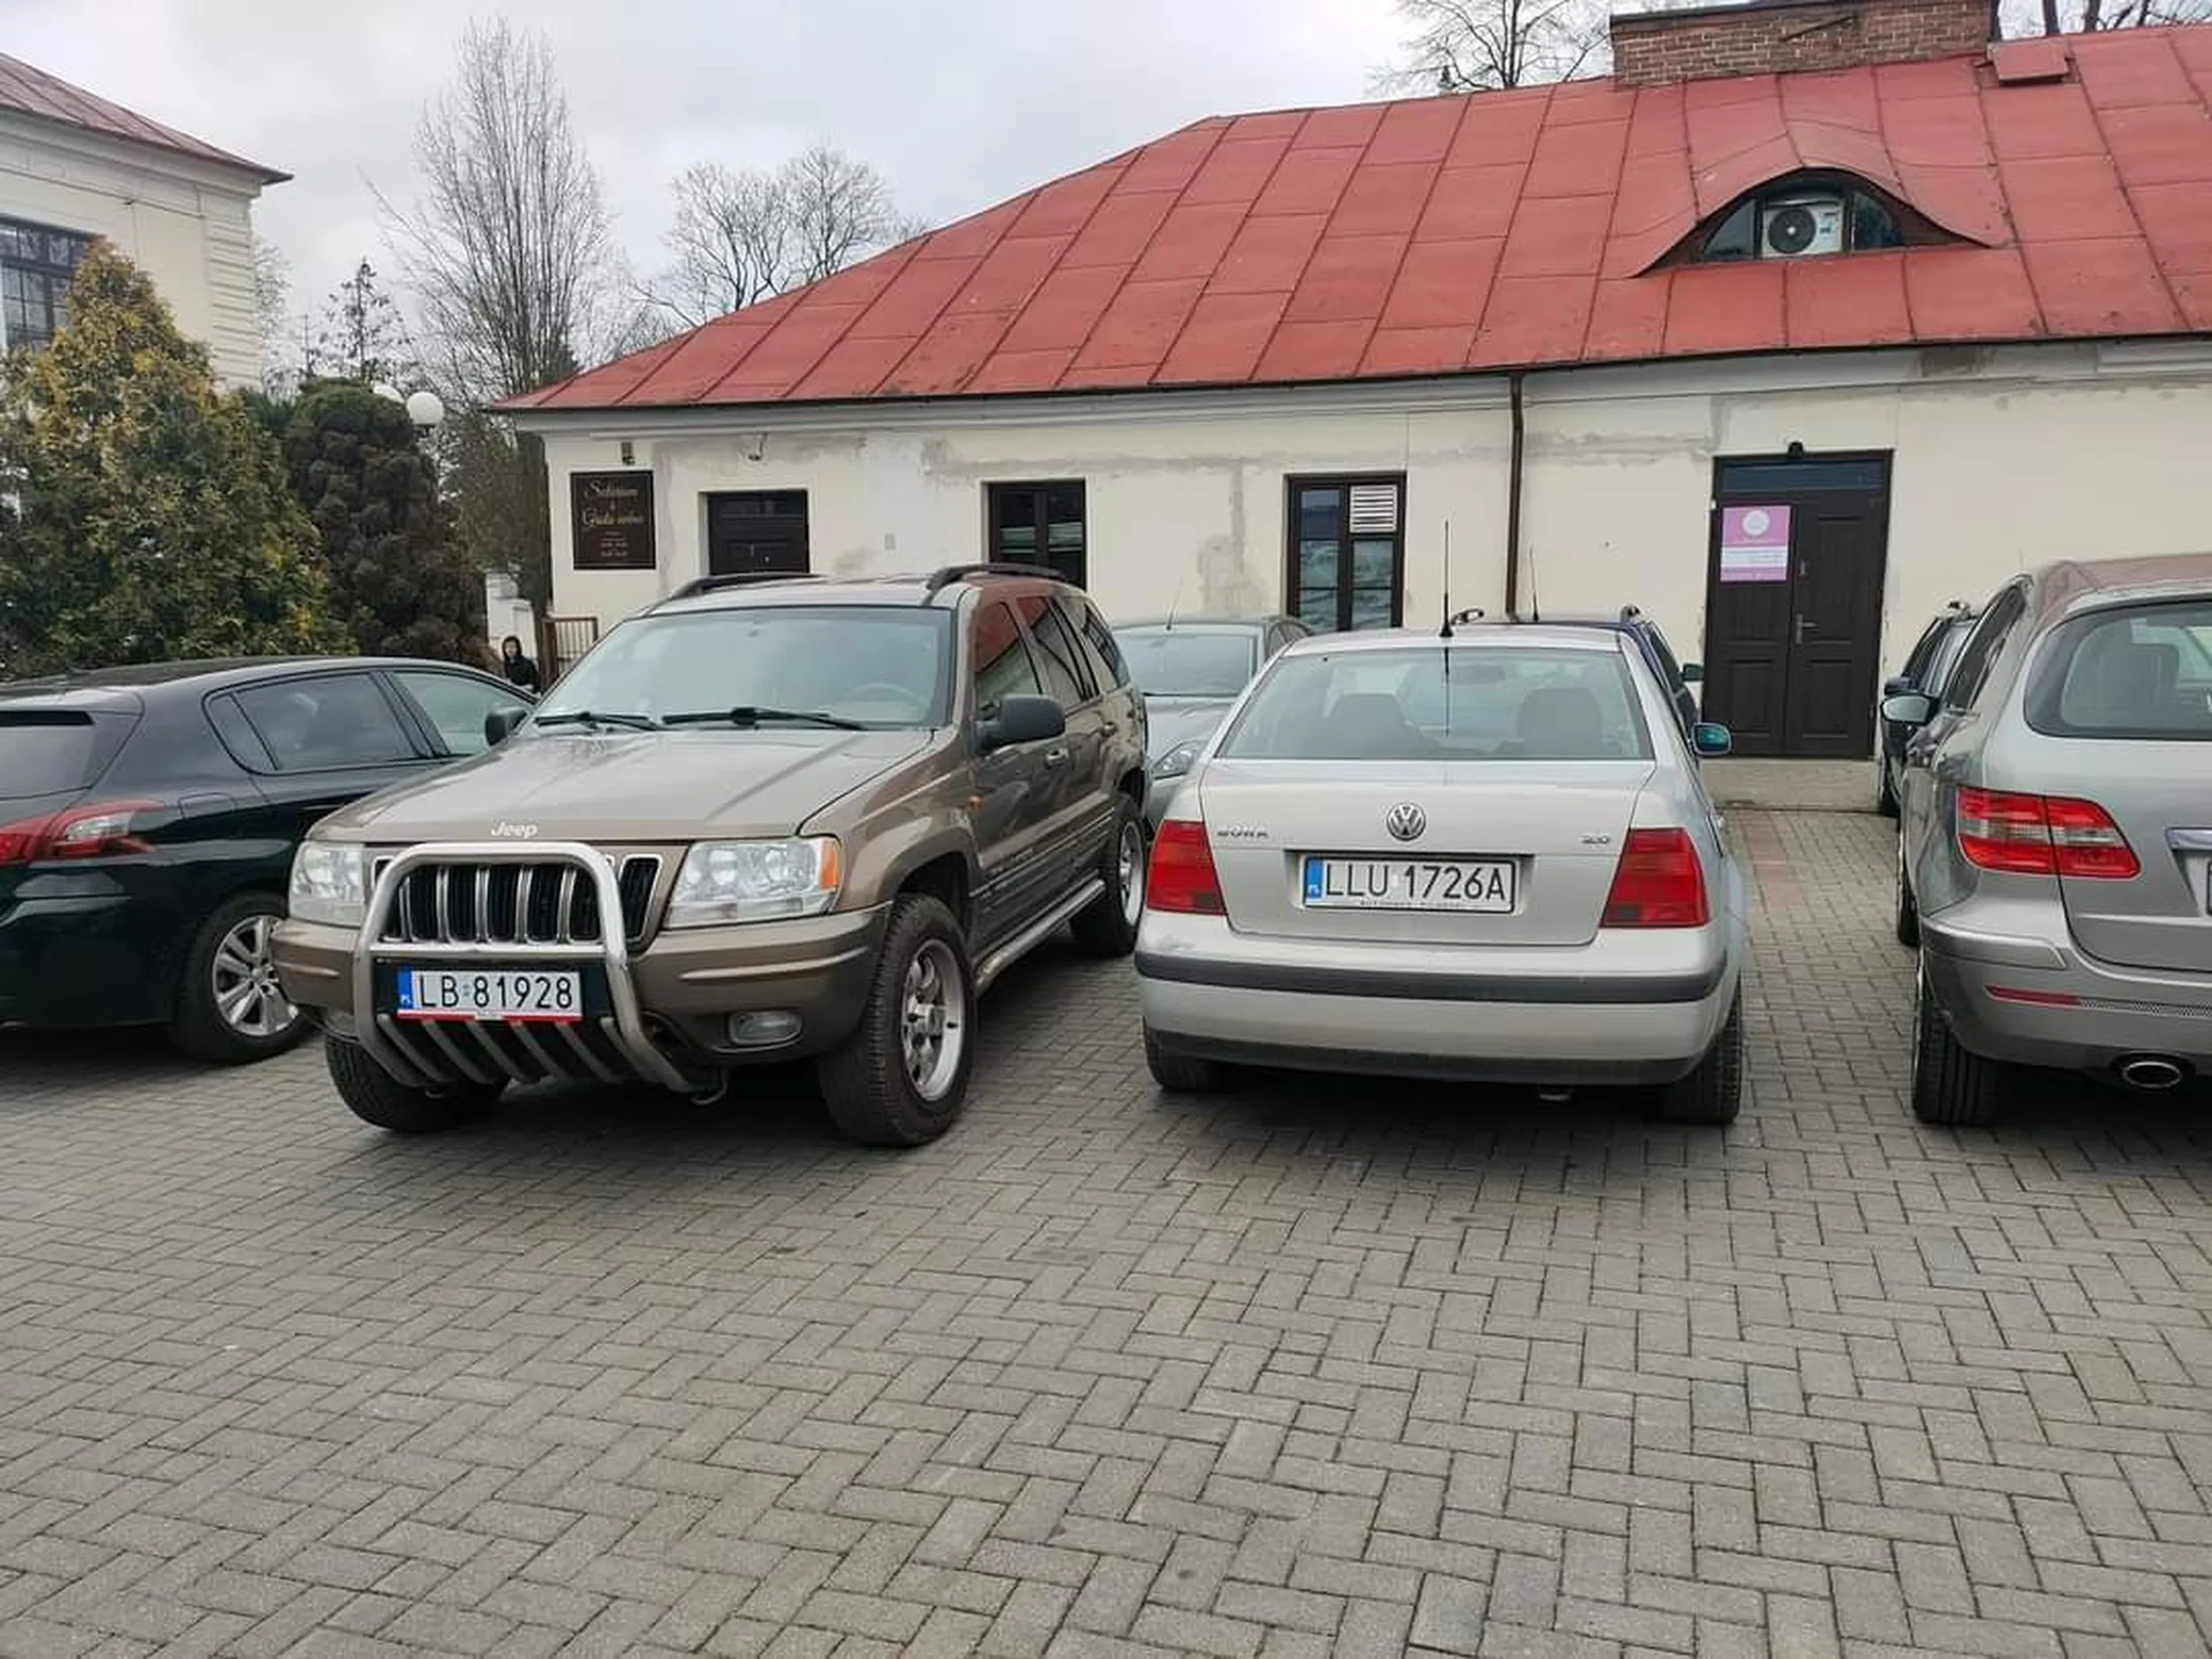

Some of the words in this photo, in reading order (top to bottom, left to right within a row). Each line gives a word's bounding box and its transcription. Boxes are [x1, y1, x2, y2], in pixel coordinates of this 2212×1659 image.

[490, 822, 538, 839] Jeep
[1326, 863, 1389, 896] LLU
[1404, 864, 1506, 901] 1726A
[419, 974, 459, 1008] LB
[473, 975, 572, 1009] 81928
